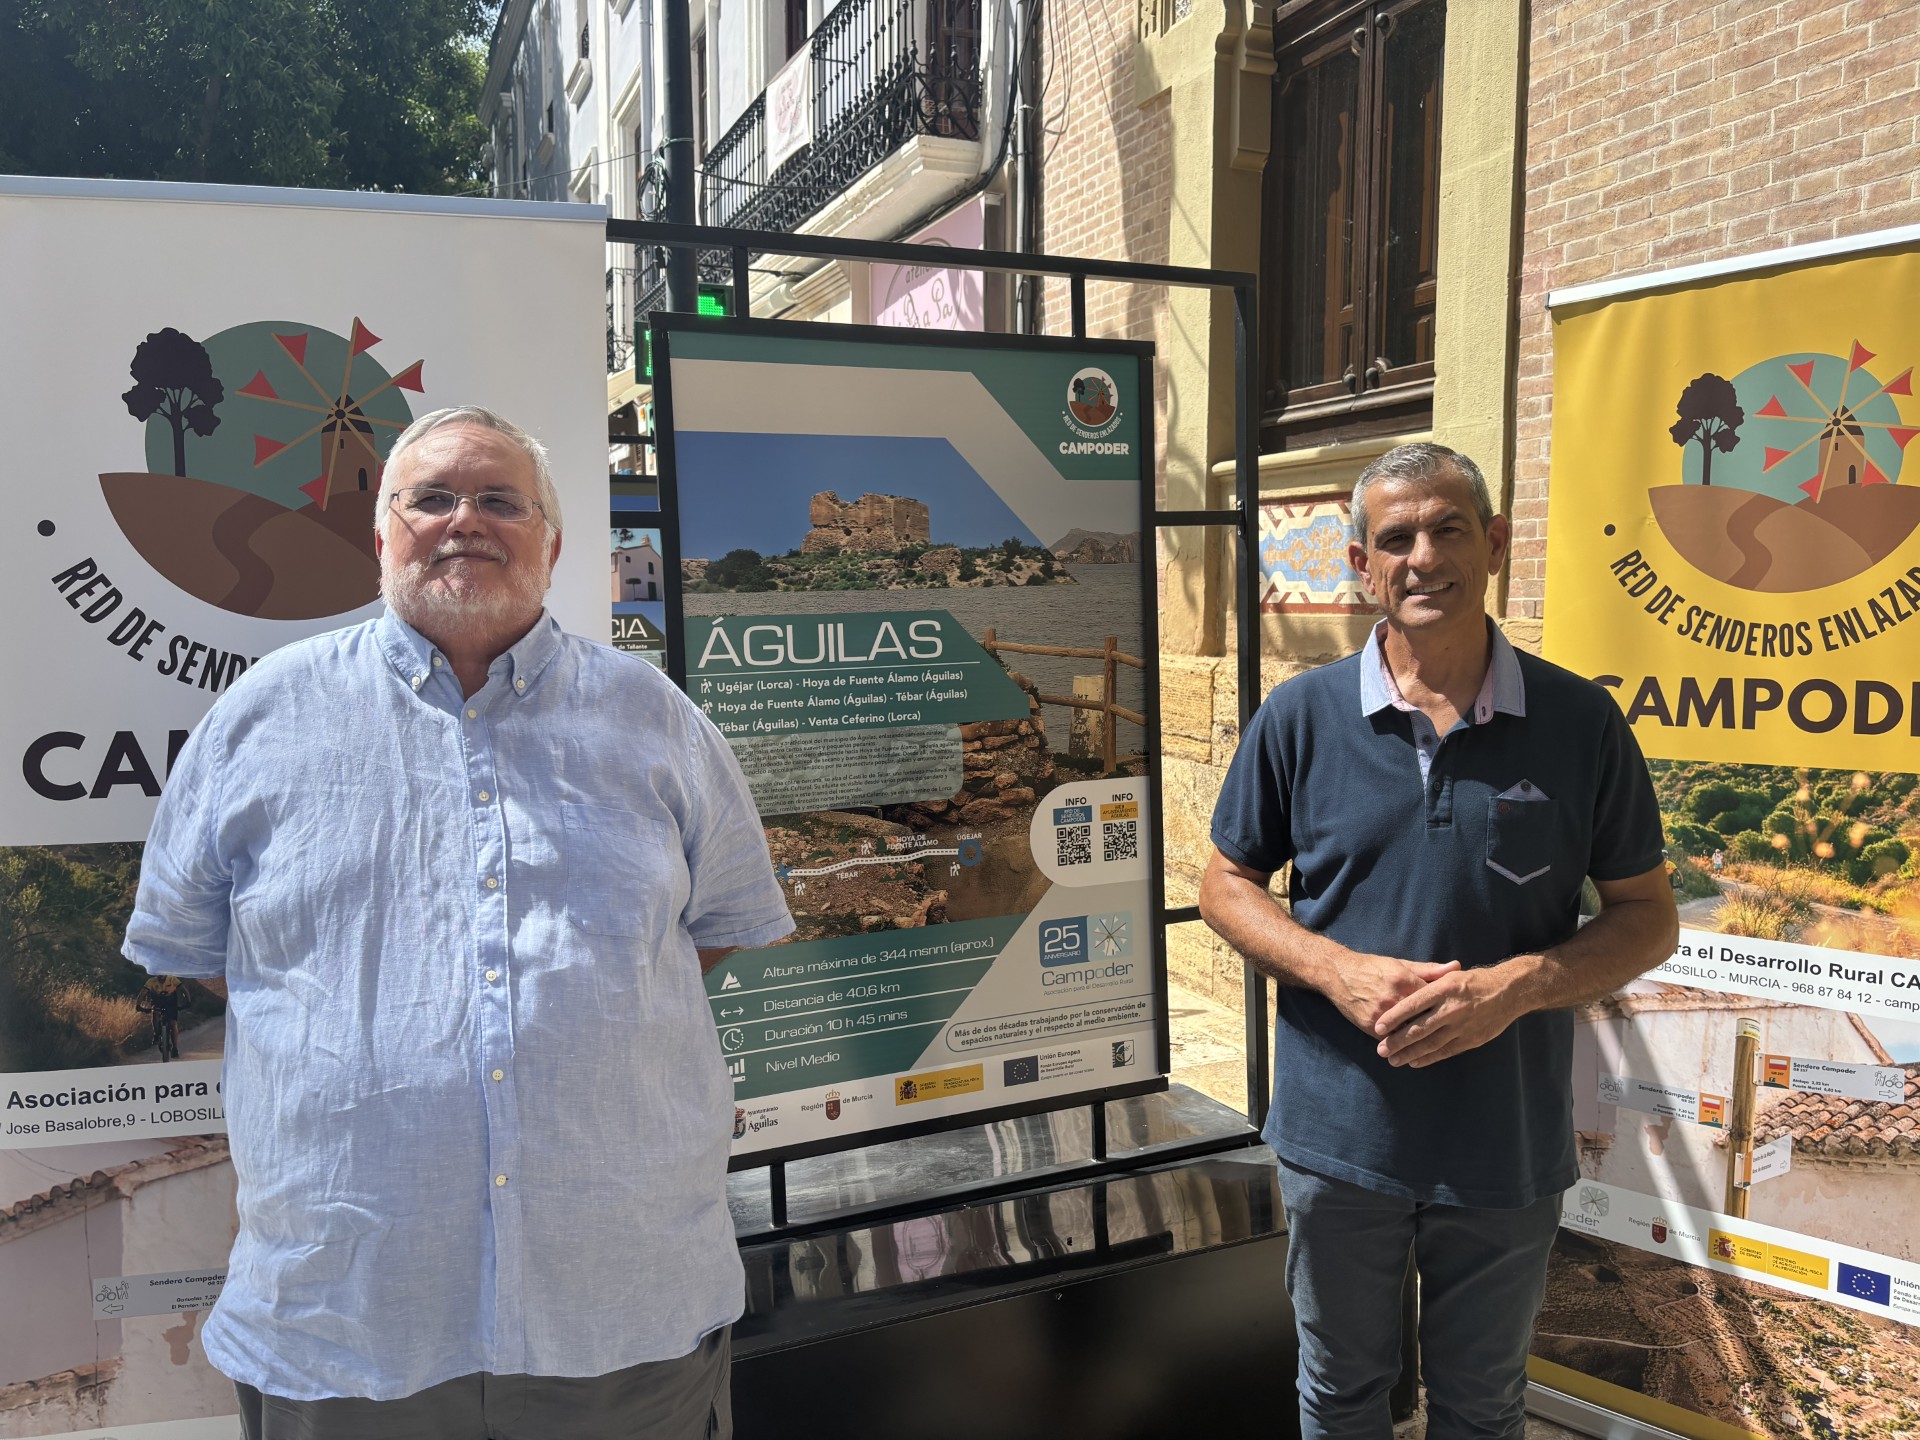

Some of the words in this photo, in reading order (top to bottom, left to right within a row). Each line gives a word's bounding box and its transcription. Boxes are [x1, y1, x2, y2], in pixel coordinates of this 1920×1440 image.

[1070, 424, 1076, 432] DE
[1076, 428, 1099, 439] SENDEROS
[1100, 416, 1121, 438] ENLAZADOS
[1059, 442, 1129, 455] CAMPODER
[1610, 549, 1657, 597] RED
[1644, 585, 1685, 625] DE
[1677, 606, 1812, 657] SENDEROS
[51, 557, 123, 623] RED
[107, 607, 166, 661] DE
[158, 635, 258, 692] SEND
[698, 616, 942, 668] ÁGUILAS
[717, 681, 753, 694] Ugéjar
[757, 679, 793, 691] (Lorca)
[803, 677, 830, 689] Hoya
[833, 676, 846, 686] de
[850, 675, 884, 685] Fuente
[887, 671, 919, 682] Álamo
[921, 670, 963, 682] (Águilas)
[718, 701, 746, 714] Hoya
[750, 700, 763, 710] de
[767, 698, 804, 709] Fuente
[808, 694, 840, 707] Álamo
[843, 693, 887, 707] (Águilas)
[896, 690, 923, 701] Tébar
[926, 688, 967, 702] (Águilas)
[719, 721, 749, 732] Tébar
[753, 719, 799, 732] (Águilas)
[808, 716, 838, 727] Venta
[842, 713, 884, 724] Ceferino
[888, 711, 921, 722] (Lorca)
[1066, 797, 1086, 806] INFO
[1112, 793, 1133, 801] INFO
[887, 841, 912, 850] FUENTE
[1044, 925, 1080, 952] 25
[763, 965, 804, 979] Altura
[807, 958, 857, 972] máxima
[861, 954, 876, 964] de
[880, 949, 907, 961] 344
[909, 945, 947, 957] msnm
[951, 937, 994, 954] (aprox.)
[1044, 951, 1081, 960] ANIVERSARIO
[1698, 946, 1713, 960] el
[1721, 947, 1821, 976] Desarrollo
[1829, 963, 1883, 985] Rural
[1042, 962, 1133, 986] Campoder
[764, 993, 824, 1012] Distancia
[827, 990, 843, 1002] de
[846, 985, 877, 999] 40,6
[880, 982, 900, 994] km
[1729, 973, 1780, 990] MURCIA
[1791, 982, 1814, 995] 968
[1818, 986, 1832, 997] 87
[1837, 988, 1852, 1000] 84
[1857, 992, 1872, 1004] 12
[765, 1023, 823, 1041] Duración
[826, 1019, 842, 1031] 10
[845, 1018, 853, 1028] h
[857, 1014, 875, 1025] 45
[878, 1010, 907, 1023] mins
[955, 1029, 971, 1038] Más
[984, 1025, 996, 1033] dos
[999, 1020, 1028, 1031] décadas
[1030, 1014, 1068, 1026] trabajando
[1070, 1012, 1082, 1021] por
[1092, 1003, 1135, 1016] conservación
[1137, 1001, 1146, 1009] de
[961, 1036, 992, 1046] espacios
[994, 1030, 1027, 1040] naturales
[1036, 1026, 1042, 1034] el
[1044, 1022, 1074, 1033] respecto
[1084, 1016, 1105, 1026] medio
[1108, 1011, 1141, 1022] ambiente.
[766, 1057, 797, 1072] Nivel
[801, 1052, 839, 1066] Medio
[1040, 1053, 1056, 1061] Unión
[1057, 1049, 1080, 1059] Europea
[1793, 1062, 1820, 1070] Sendero
[1822, 1065, 1856, 1075] Campoder
[7, 1083, 145, 1109] Asociación
[155, 1081, 208, 1103] para
[801, 1103, 823, 1112] Región
[852, 1094, 873, 1102] Murcia
[1639, 1084, 1662, 1094] Sendero
[1665, 1090, 1695, 1100] Campoder
[6, 1122, 40, 1134] Jose
[46, 1113, 135, 1133] Basalobre,9
[748, 1117, 778, 1132] Águilas
[1629, 1217, 1650, 1227] Región
[1679, 1230, 1700, 1241] Murcia
[150, 1278, 182, 1286] Sendero
[185, 1275, 226, 1283] Campoder
